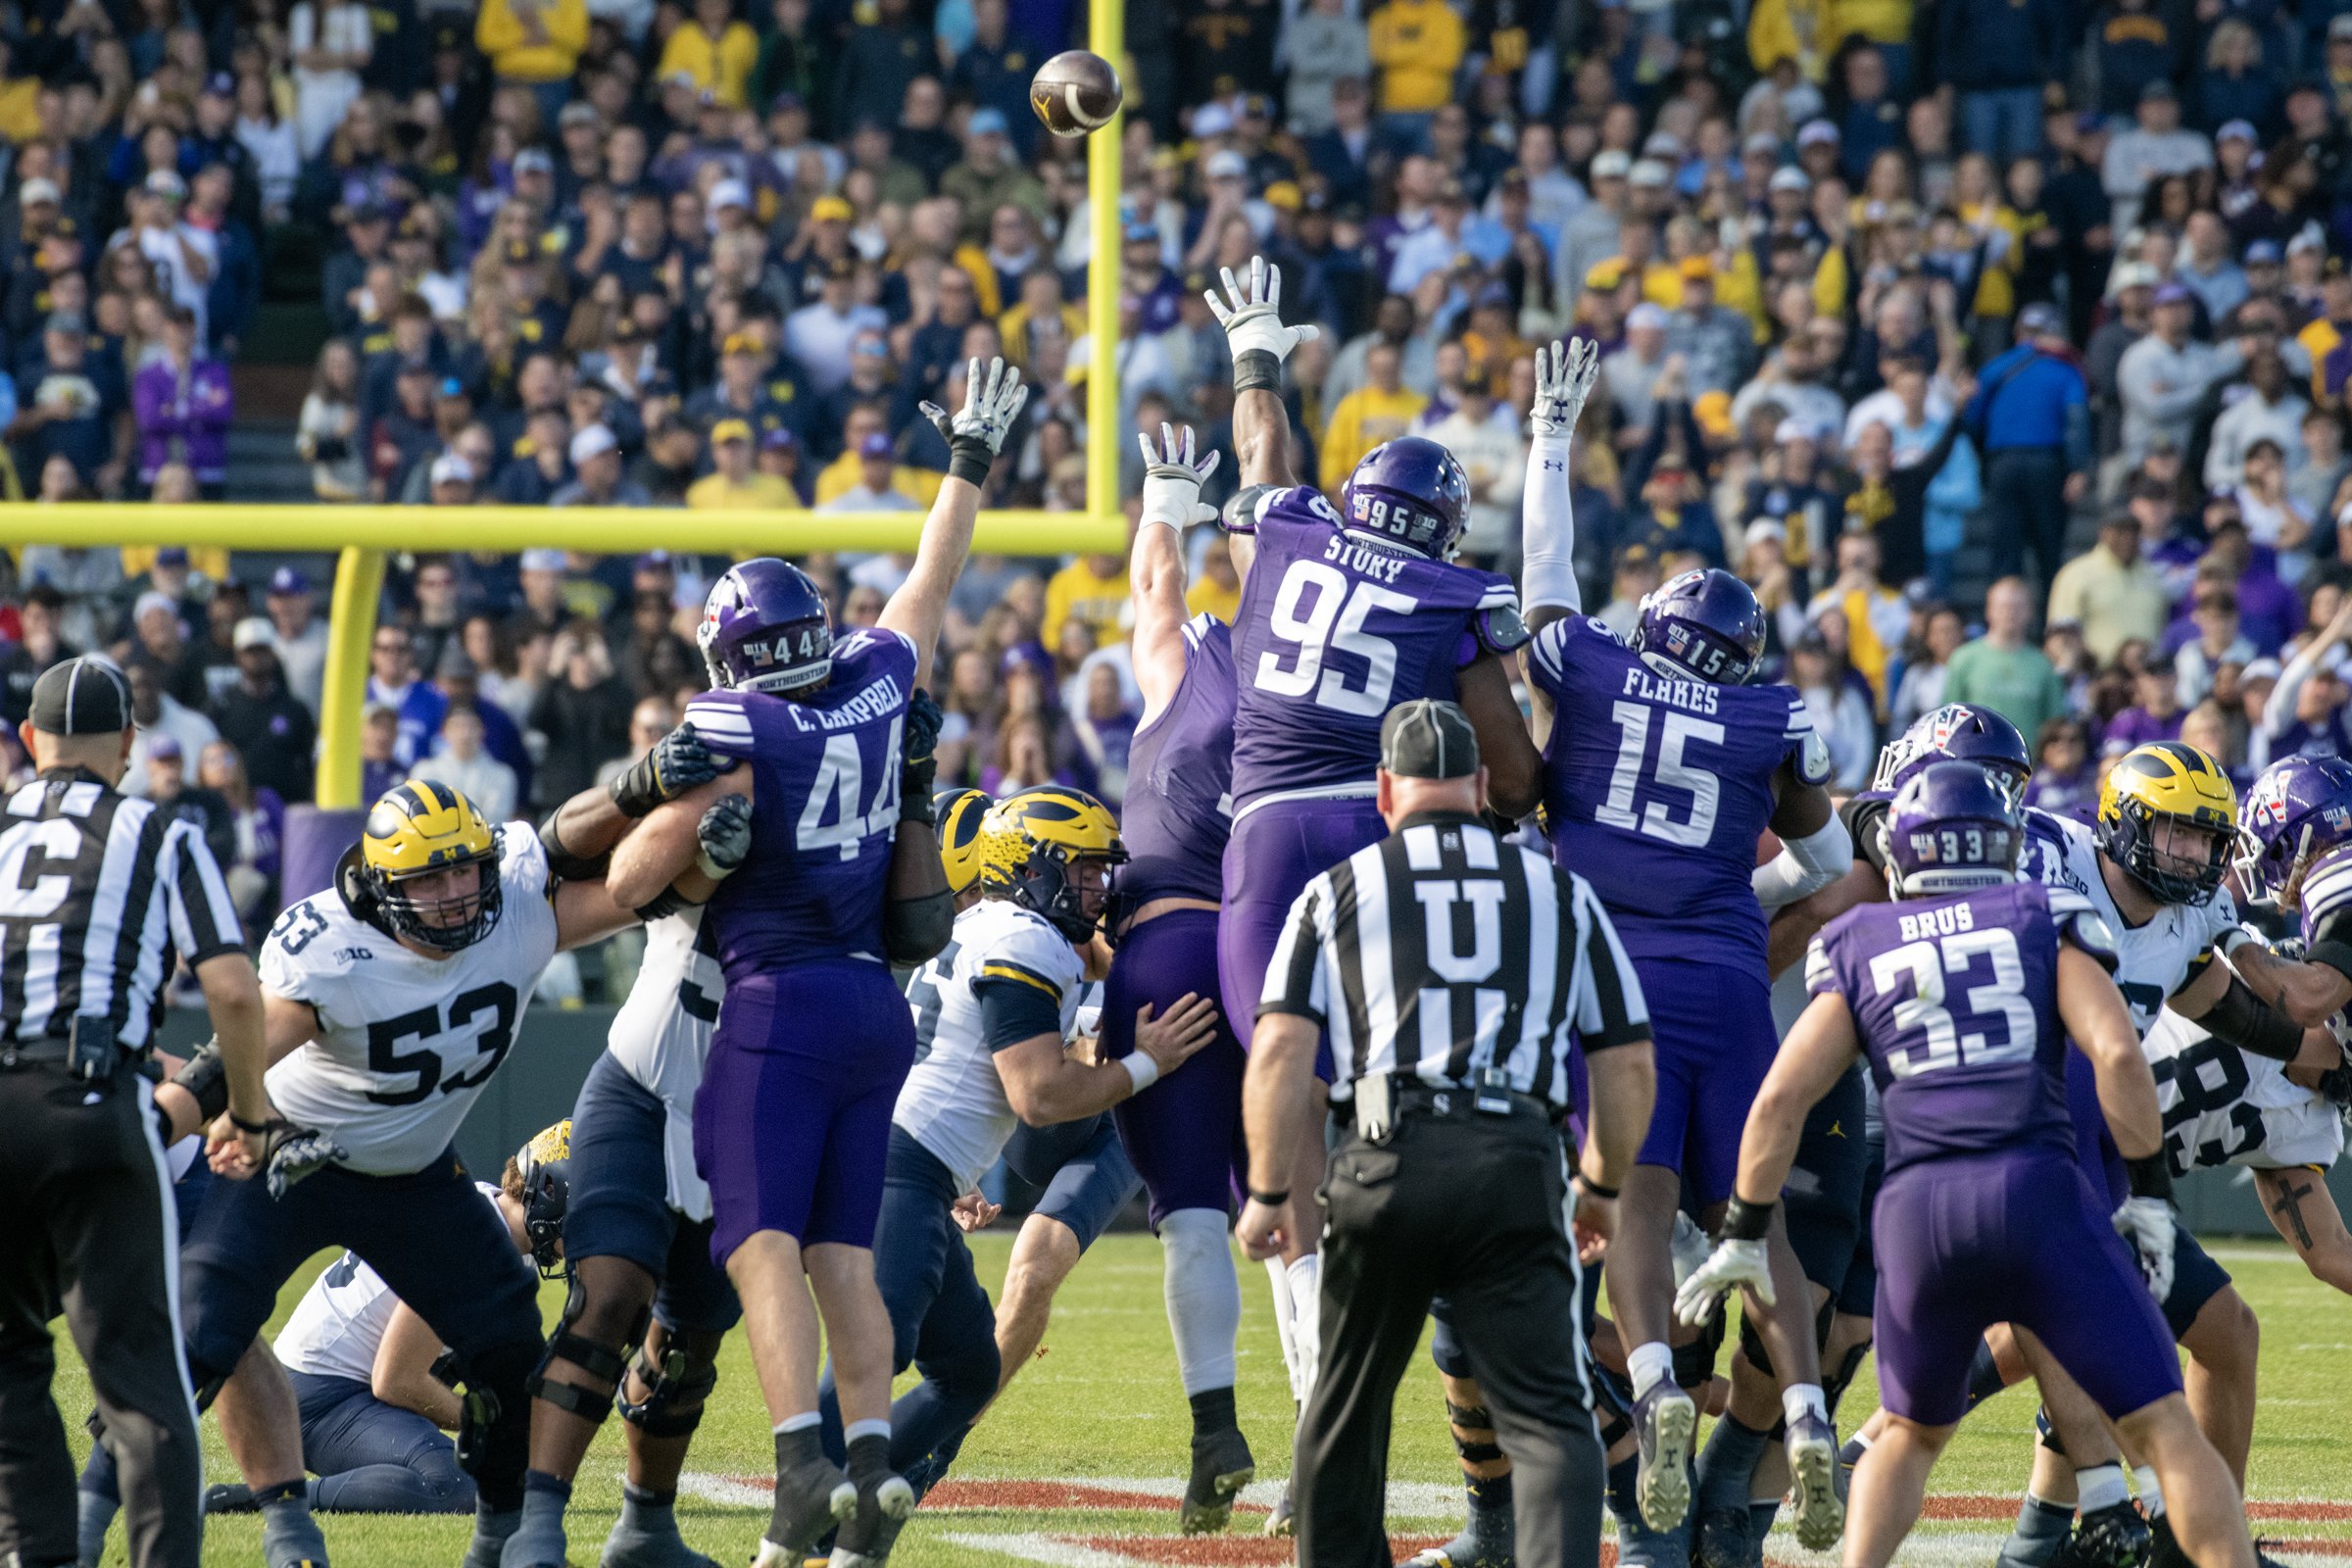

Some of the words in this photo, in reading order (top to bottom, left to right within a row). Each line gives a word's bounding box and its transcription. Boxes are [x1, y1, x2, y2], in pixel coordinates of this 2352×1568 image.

[1369, 500, 1409, 535] 95
[774, 630, 814, 664] 44
[1253, 559, 1419, 717] 95
[1687, 639, 1726, 676] 15
[787, 704, 817, 732] C.
[796, 713, 904, 862] 44
[1594, 700, 1726, 849] 15
[0, 817, 82, 918] C
[1940, 829, 1984, 863] 33
[1414, 879, 1506, 982] U
[1898, 903, 1974, 942] BRUS
[367, 981, 518, 1105] 53
[1869, 928, 2037, 1079] 33
